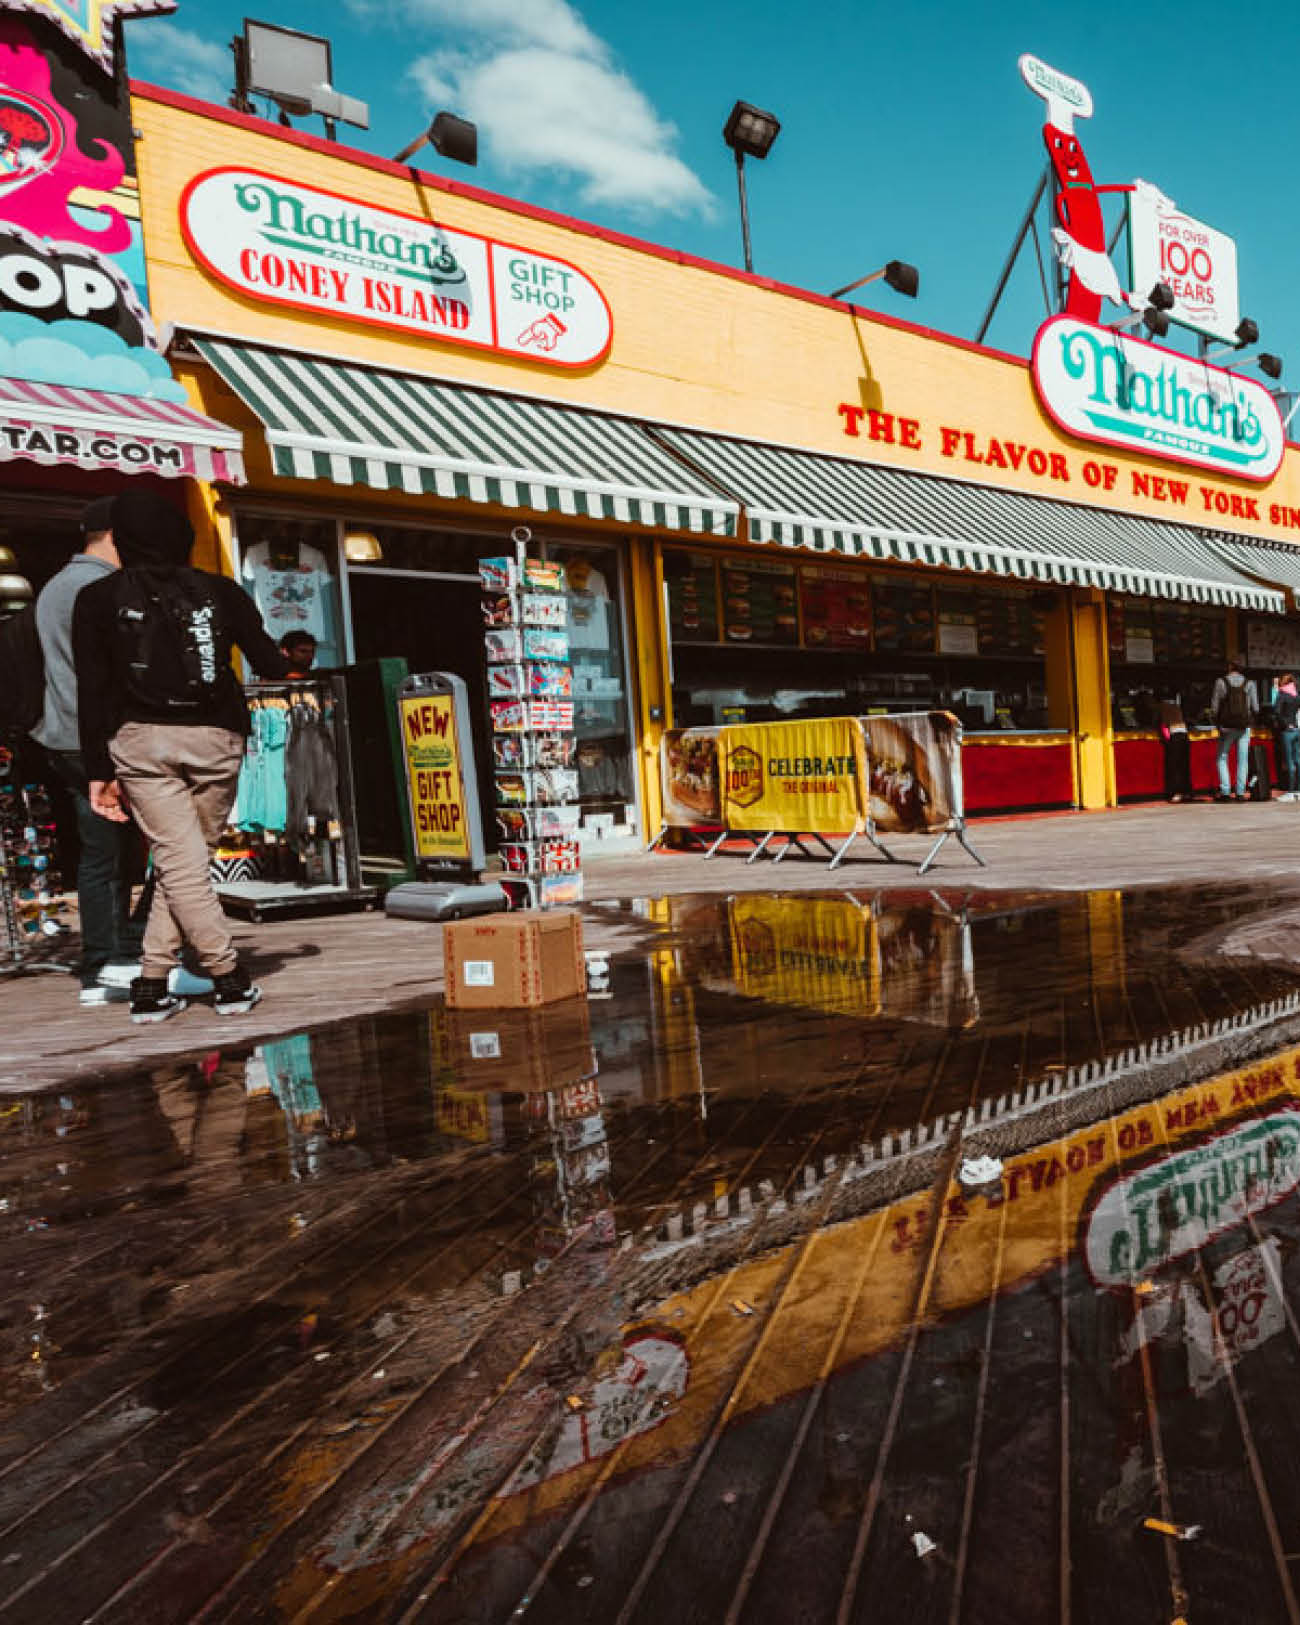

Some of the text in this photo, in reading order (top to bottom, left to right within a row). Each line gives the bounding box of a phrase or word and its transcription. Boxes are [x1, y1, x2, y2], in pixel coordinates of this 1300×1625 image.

[234, 183, 458, 274] Nathan's
[509, 259, 574, 294] GIFT
[1160, 238, 1212, 282] 100
[240, 248, 470, 331] CONEY ISLAND
[511, 283, 575, 313] SHOP
[1060, 330, 1262, 446] Nathan's
[1, 426, 183, 467] TAR.COM
[838, 402, 922, 451] THE
[941, 426, 1070, 482] FLAVOR
[1082, 460, 1118, 491] OF
[1131, 471, 1189, 506] NEW
[1200, 487, 1260, 522] YORK
[407, 704, 449, 741] NEW
[417, 770, 452, 800] GIFT
[768, 755, 856, 777] CELEBRATE
[418, 803, 460, 833] SHOP
